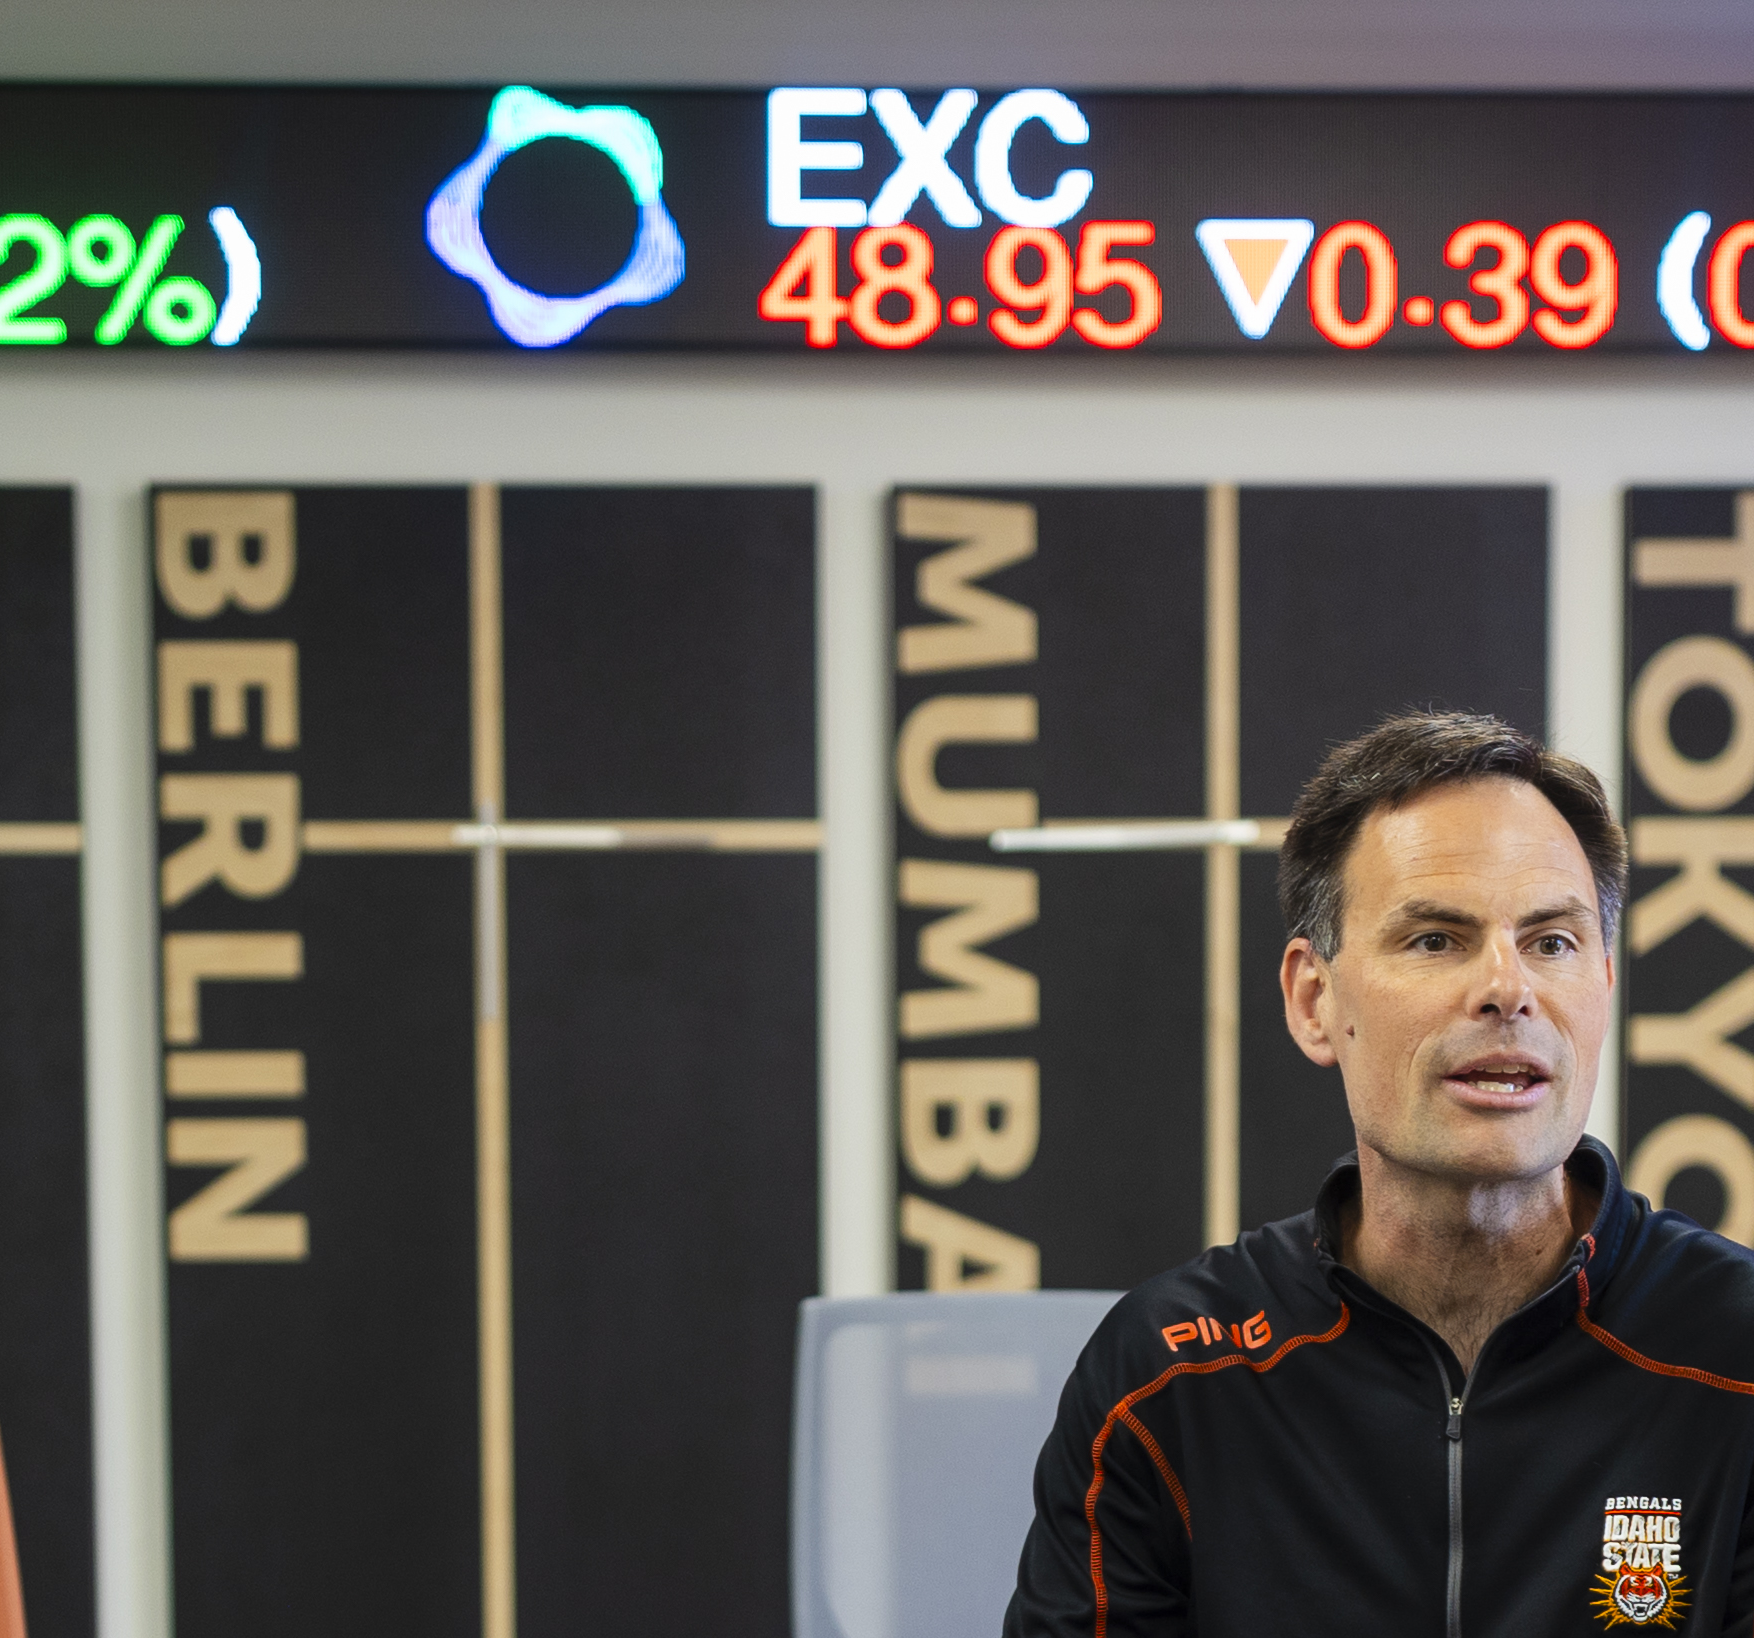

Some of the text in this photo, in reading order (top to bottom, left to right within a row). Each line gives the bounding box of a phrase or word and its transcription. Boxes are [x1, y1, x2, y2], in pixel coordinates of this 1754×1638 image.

[766, 87, 1094, 229] EXC
[757, 220, 1163, 349] 48.95
[1307, 220, 1619, 349] 0.39
[154, 490, 309, 1263] BERLIN
[1162, 1310, 1272, 1352] PING
[1605, 1496, 1682, 1510] BENGALS
[1603, 1514, 1681, 1543] IDAHO
[1601, 1541, 1682, 1573] STATE
